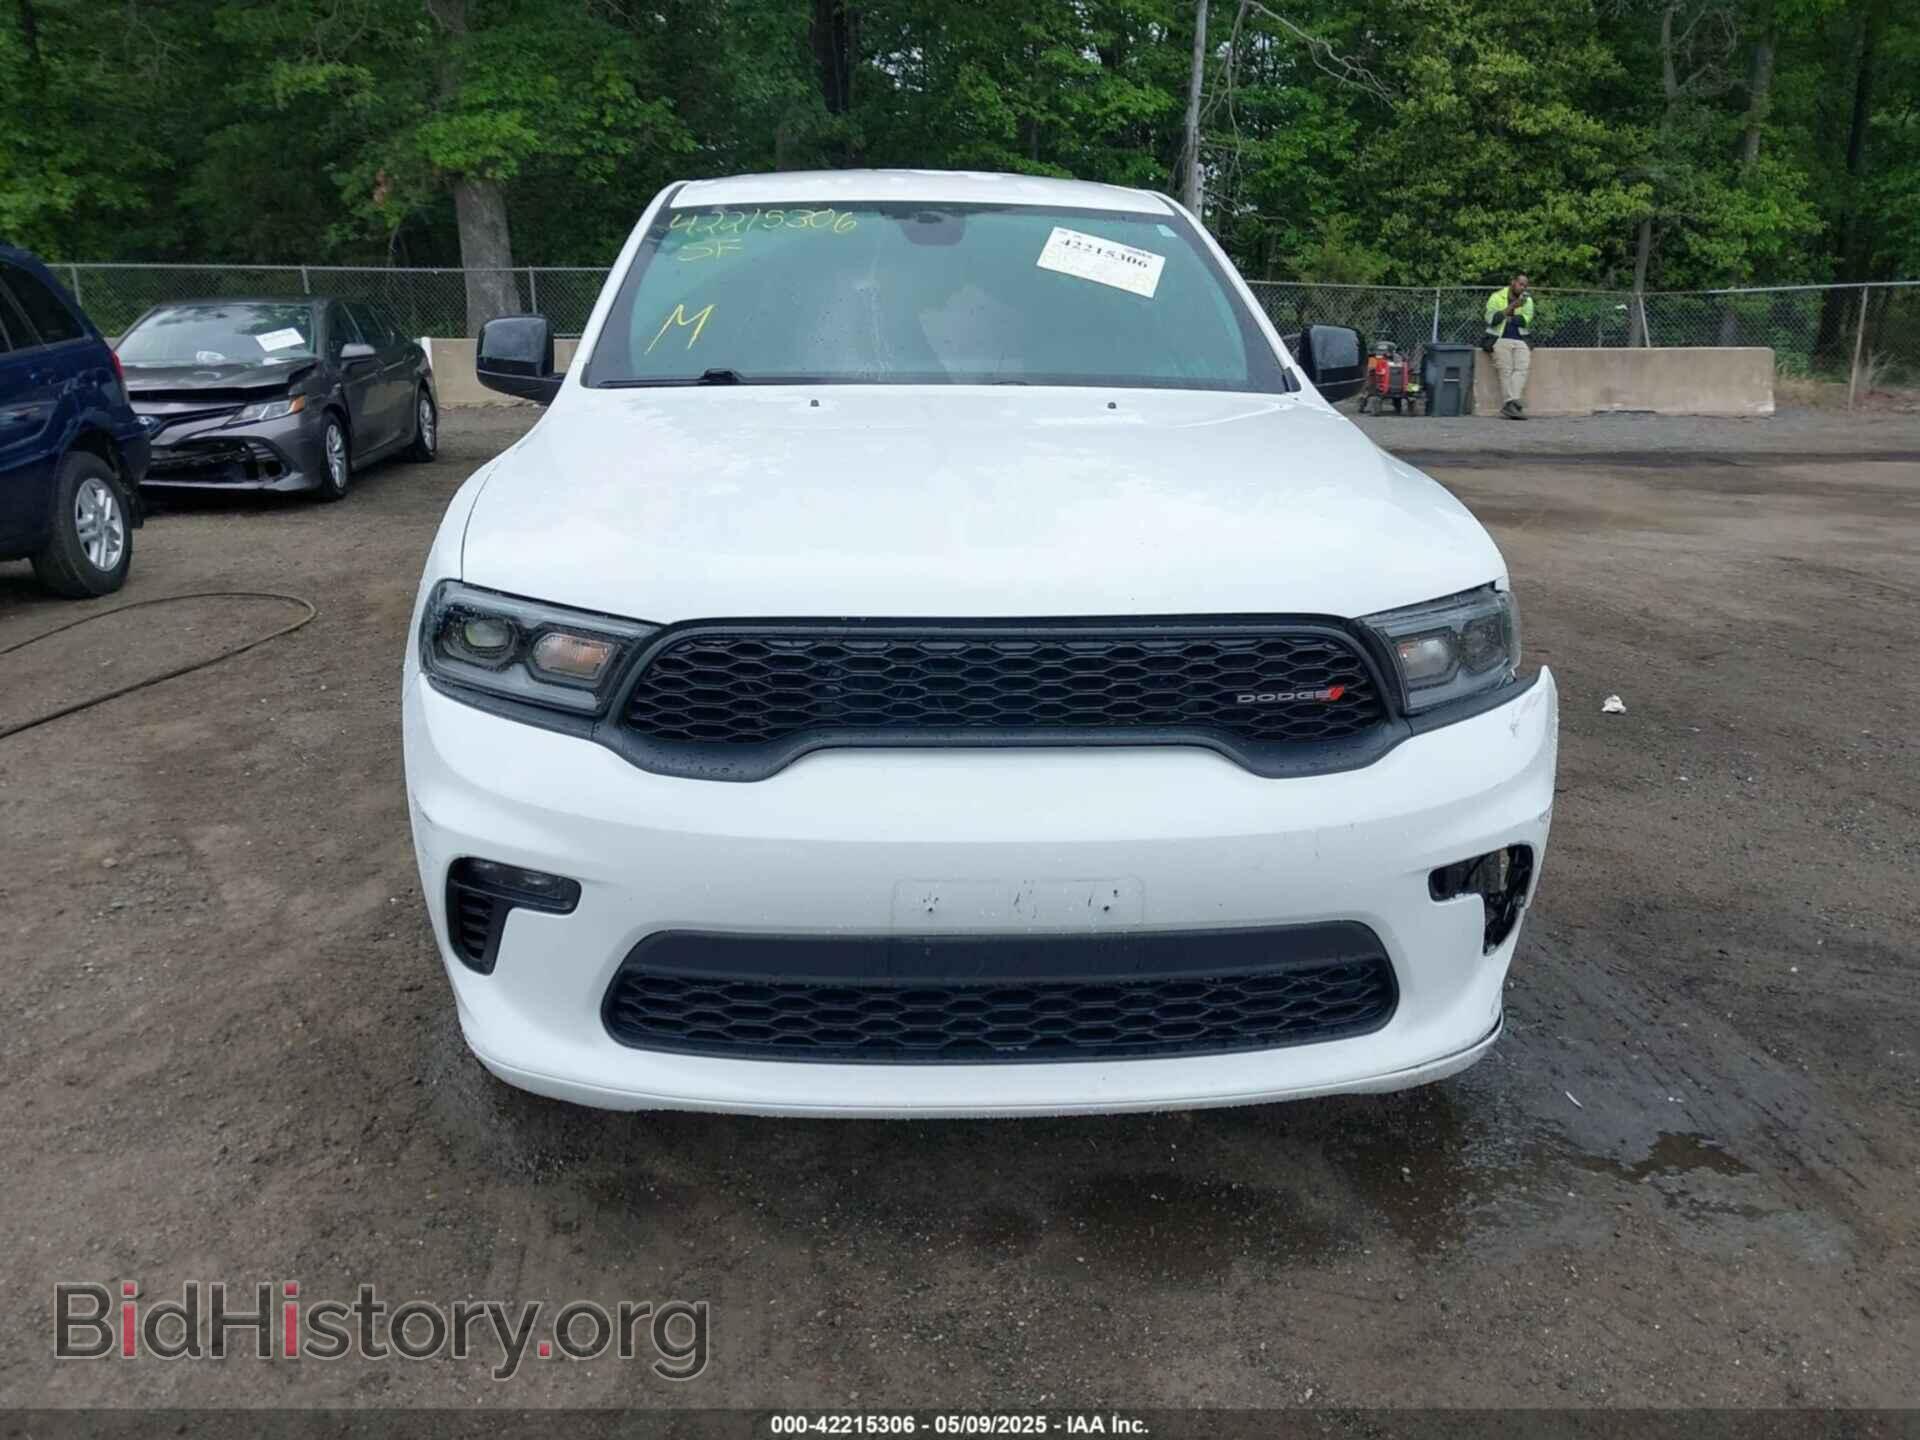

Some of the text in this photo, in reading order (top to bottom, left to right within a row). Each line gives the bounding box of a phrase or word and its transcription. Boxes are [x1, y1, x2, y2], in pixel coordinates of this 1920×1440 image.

[669, 208, 857, 234] 42215306
[645, 303, 715, 355] M
[1236, 690, 1329, 703] DODGE
